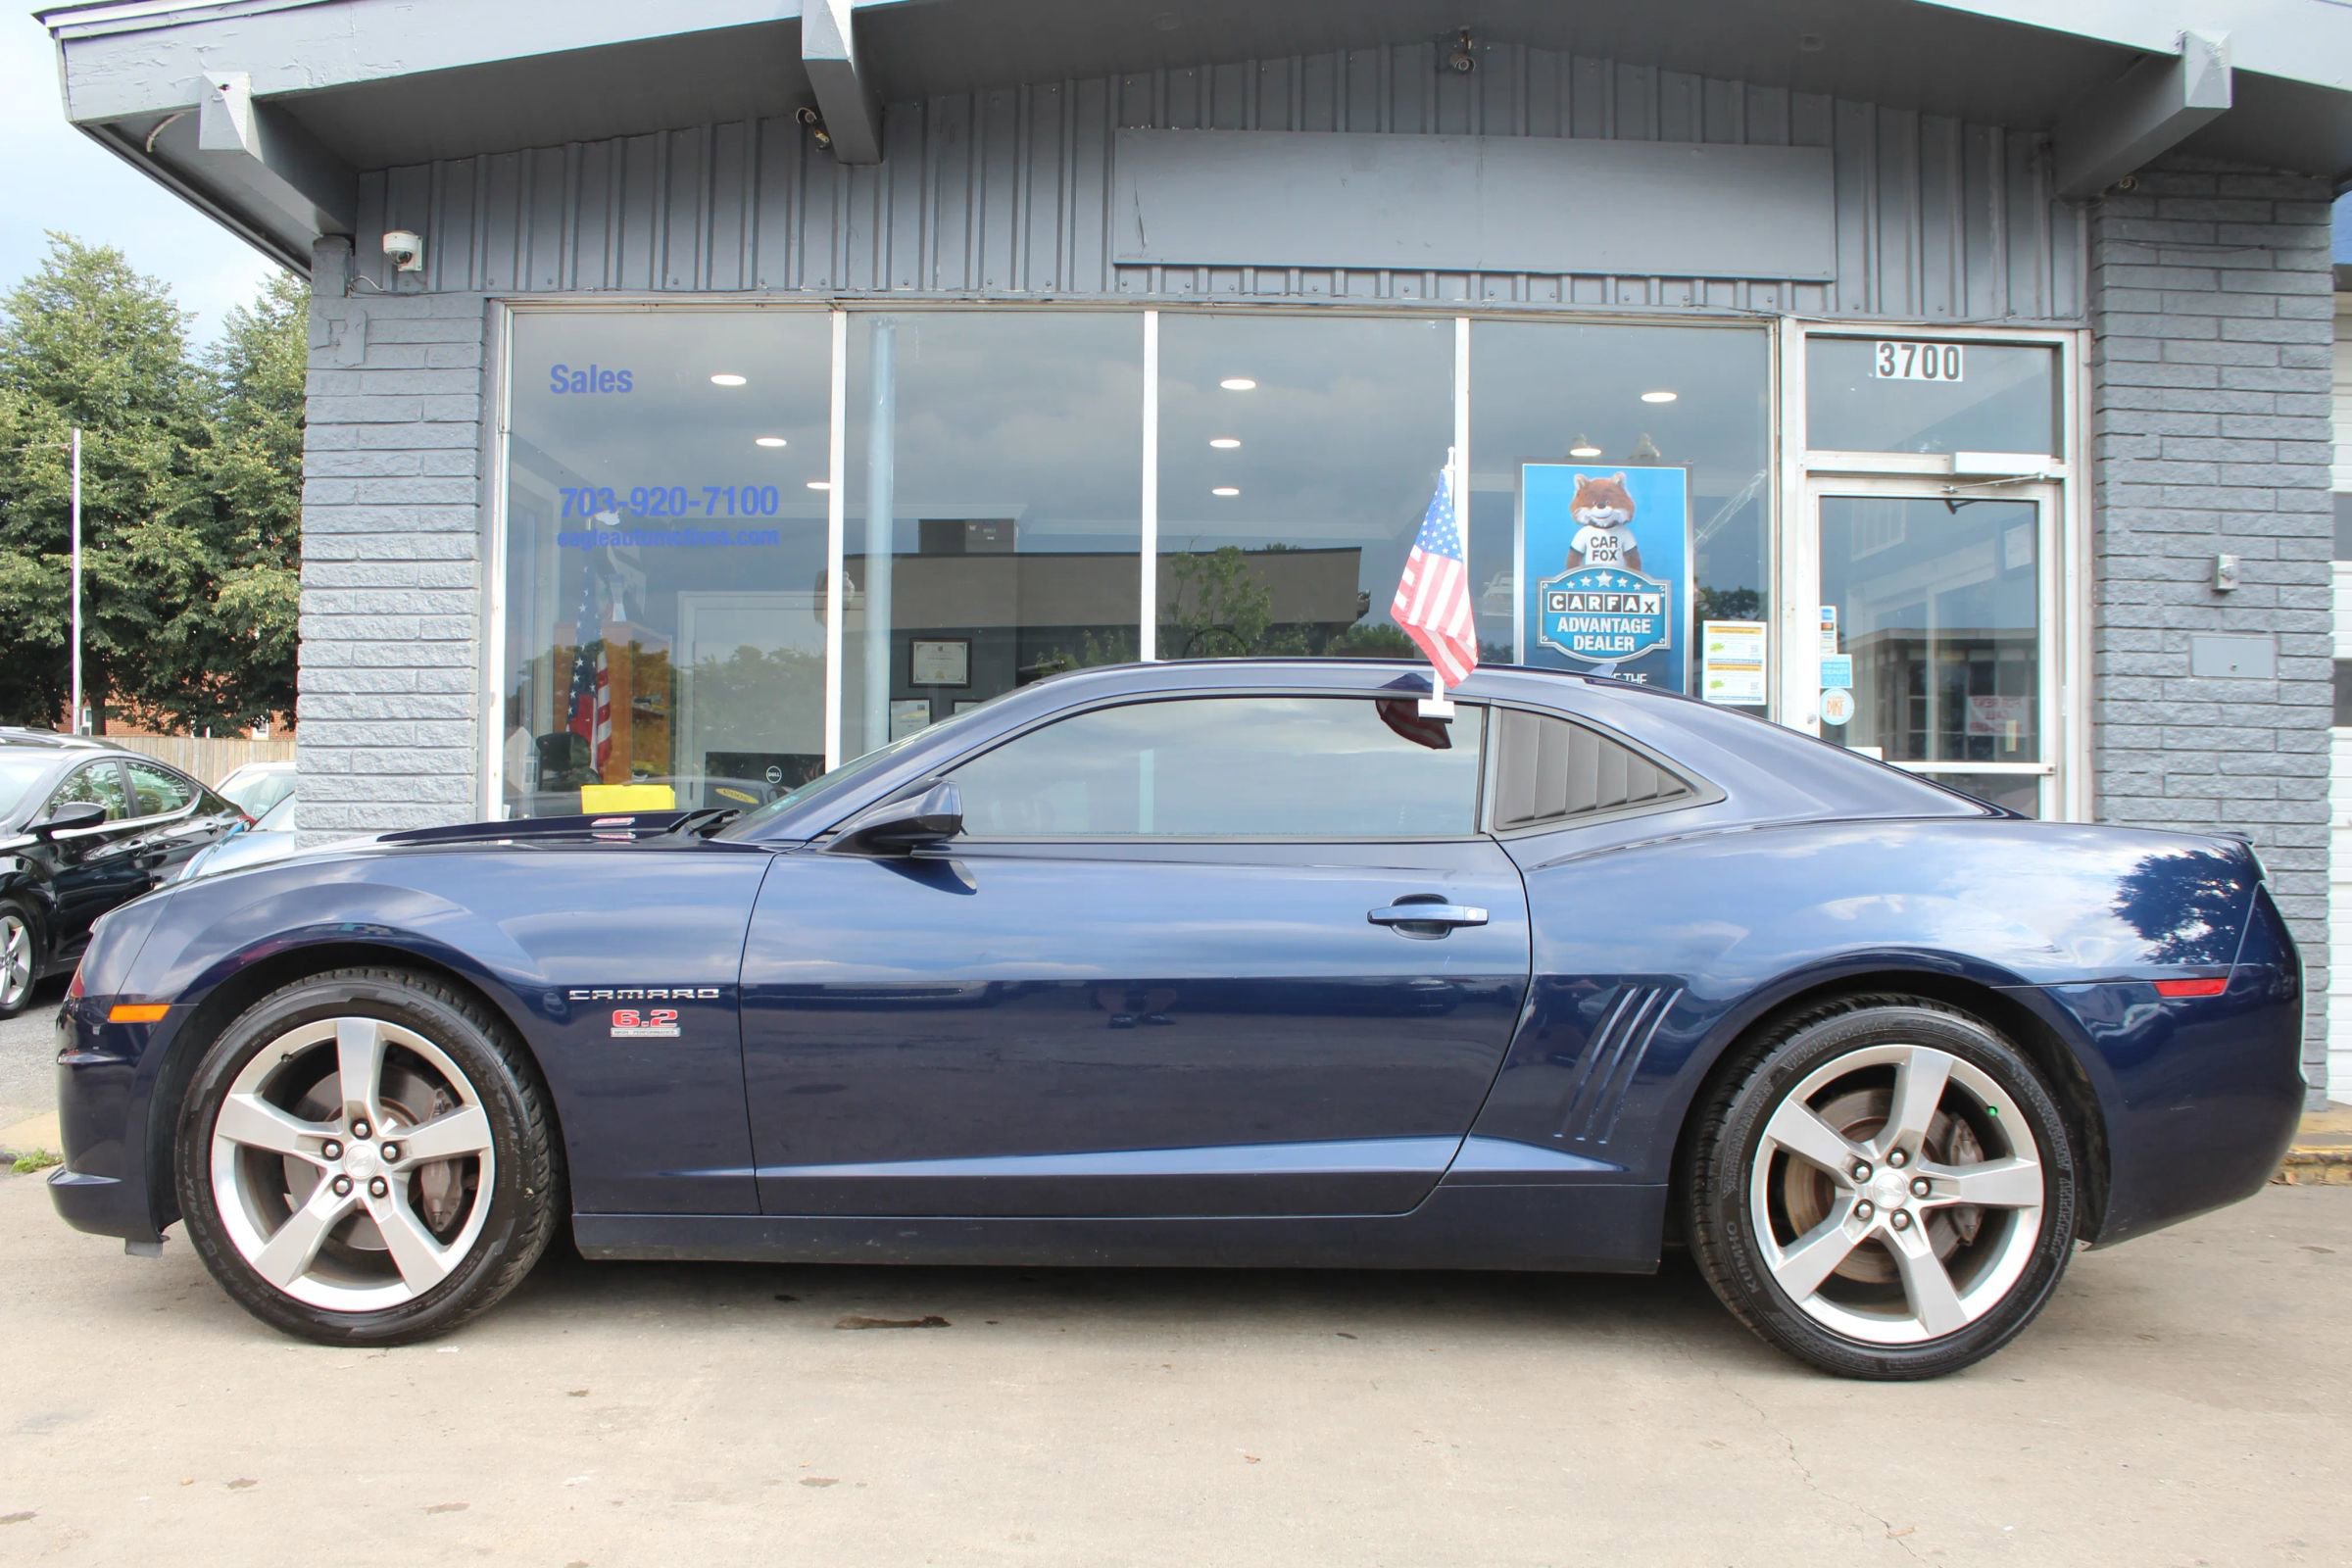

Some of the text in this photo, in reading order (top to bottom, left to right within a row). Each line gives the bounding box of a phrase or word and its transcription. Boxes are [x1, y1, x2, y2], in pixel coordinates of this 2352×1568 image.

[1879, 342, 1960, 380] 3700
[550, 364, 634, 395] Sales
[559, 485, 779, 518] 703-920-7100
[1591, 536, 1618, 549] CAR
[1592, 550, 1618, 562] FOX
[1550, 594, 1656, 614] CARFAX
[1556, 616, 1652, 634] ADVANTAGE
[1573, 634, 1636, 652] DEALER
[567, 988, 720, 1001] CAMARO
[612, 1008, 678, 1028] 6.2
[1726, 1221, 1761, 1294] KUMHO
